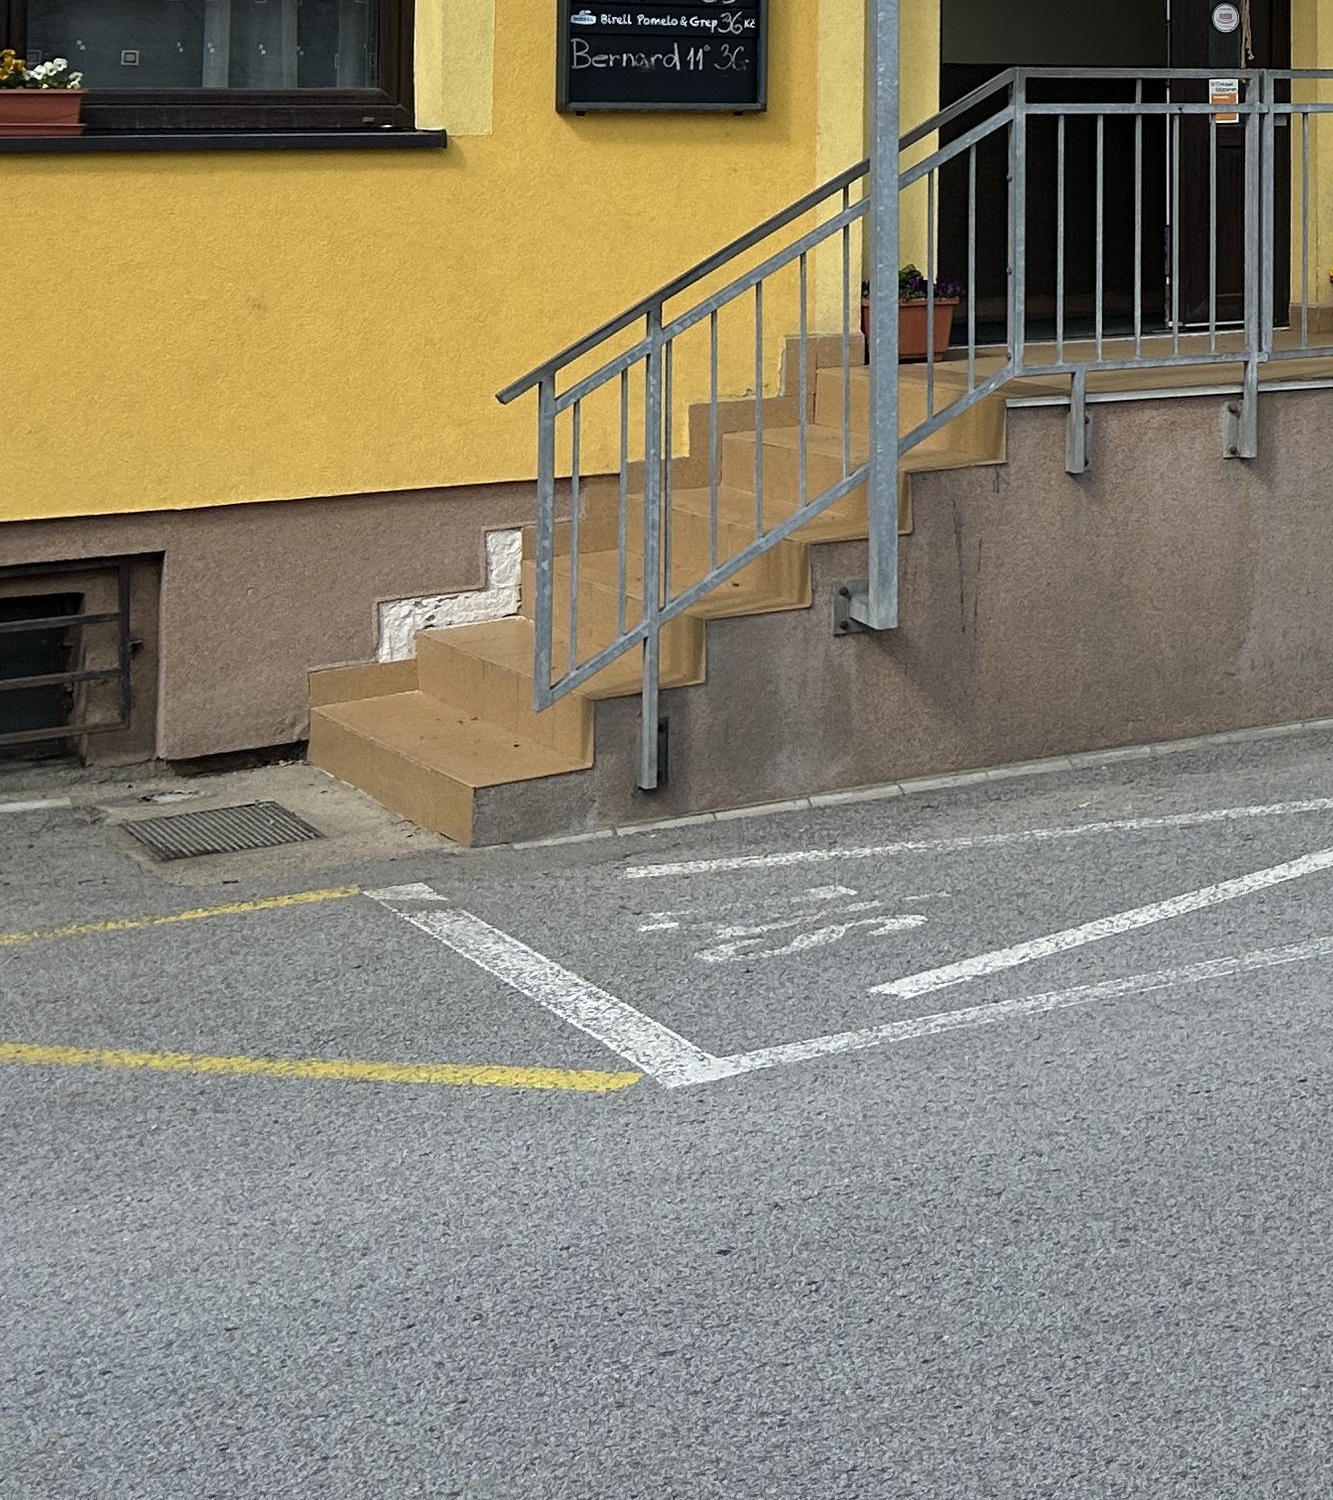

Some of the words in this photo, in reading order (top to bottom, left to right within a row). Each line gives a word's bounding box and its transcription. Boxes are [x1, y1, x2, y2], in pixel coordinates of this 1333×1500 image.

[600, 13, 633, 25] Birell
[637, 14, 678, 27] Pomelo
[680, 16, 687, 27] &
[689, 16, 718, 33] Grep
[717, 11, 744, 34] 36
[570, 38, 681, 70] Bernard
